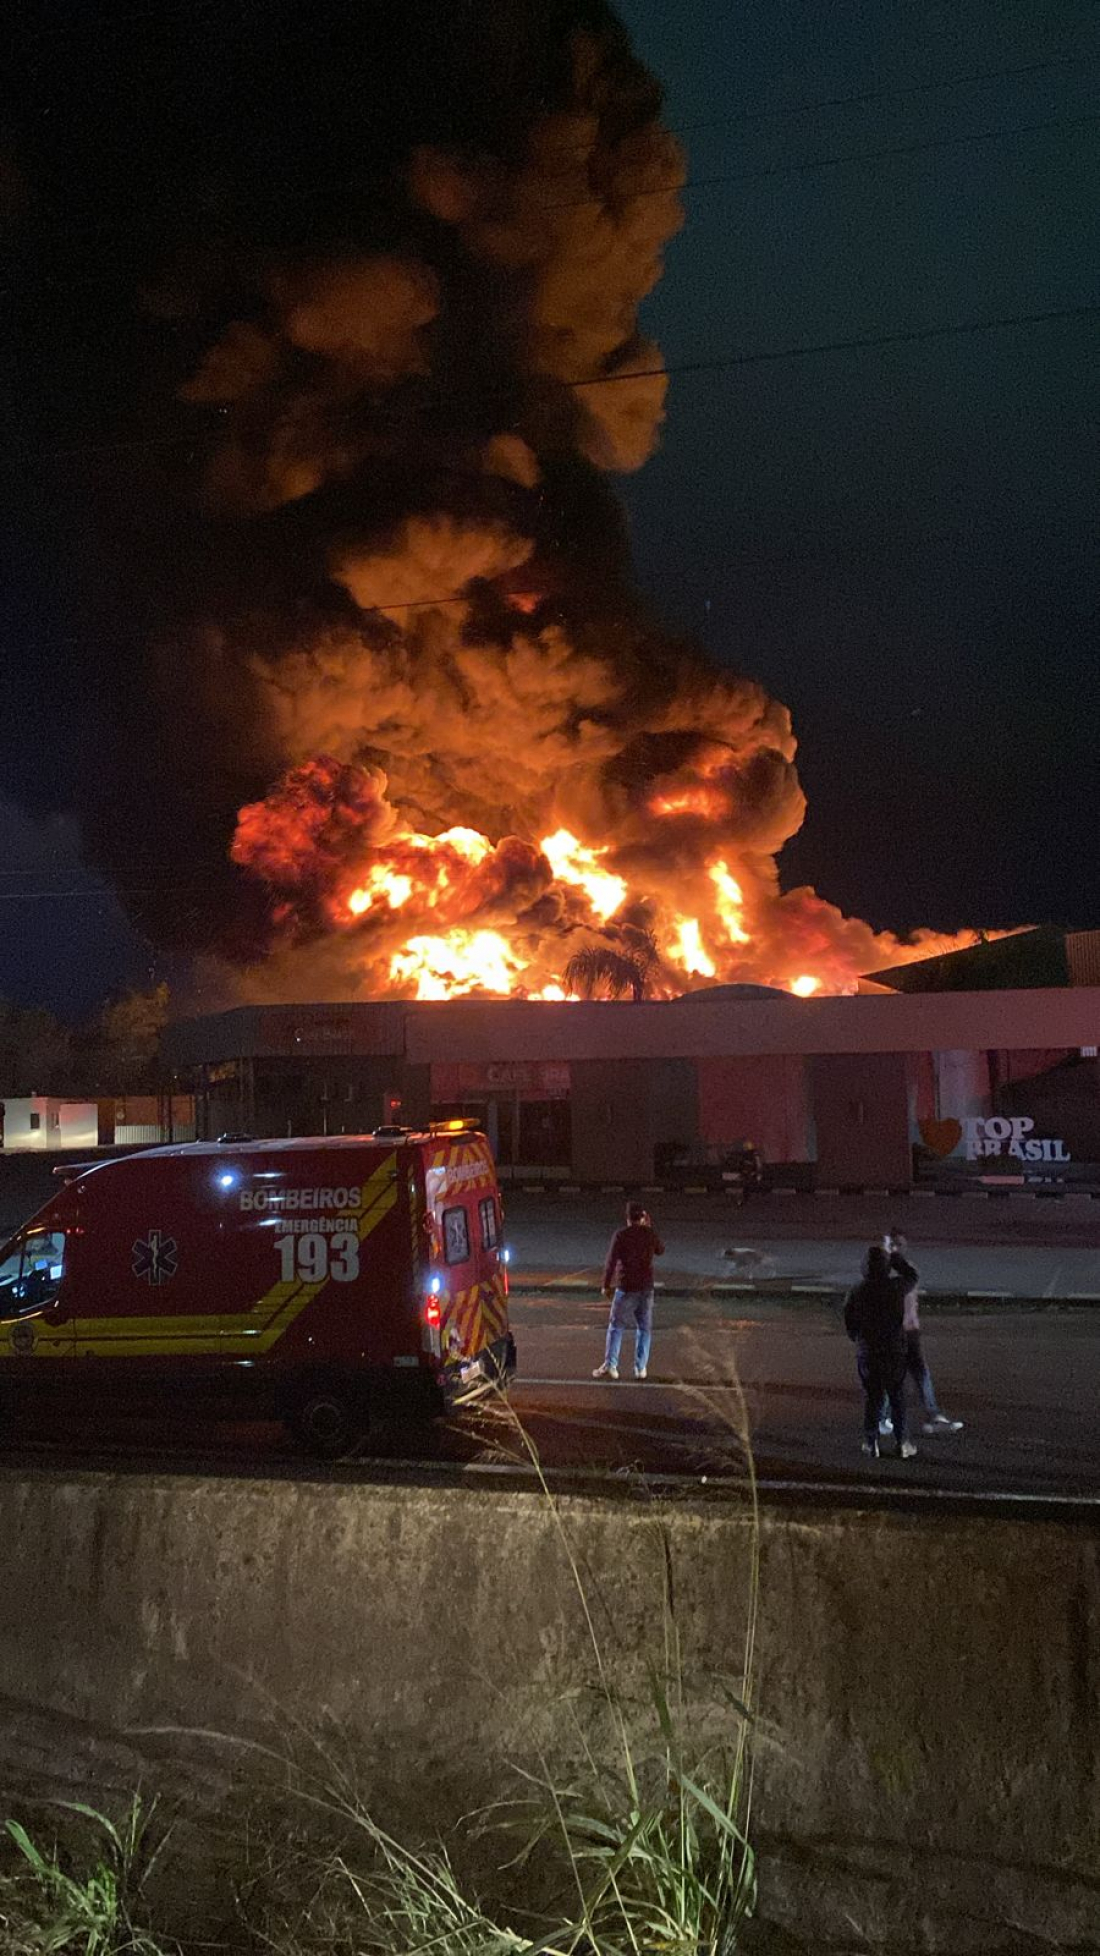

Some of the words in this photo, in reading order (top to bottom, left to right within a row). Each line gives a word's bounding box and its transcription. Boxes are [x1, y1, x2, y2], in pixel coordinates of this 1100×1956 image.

[959, 1116, 1035, 1140] TOP
[966, 1138, 1071, 1161] BRASIL
[240, 1186, 361, 1212] BOMBEIROS
[274, 1216, 359, 1233] EMERGÊNCIA
[273, 1232, 360, 1283] 193
